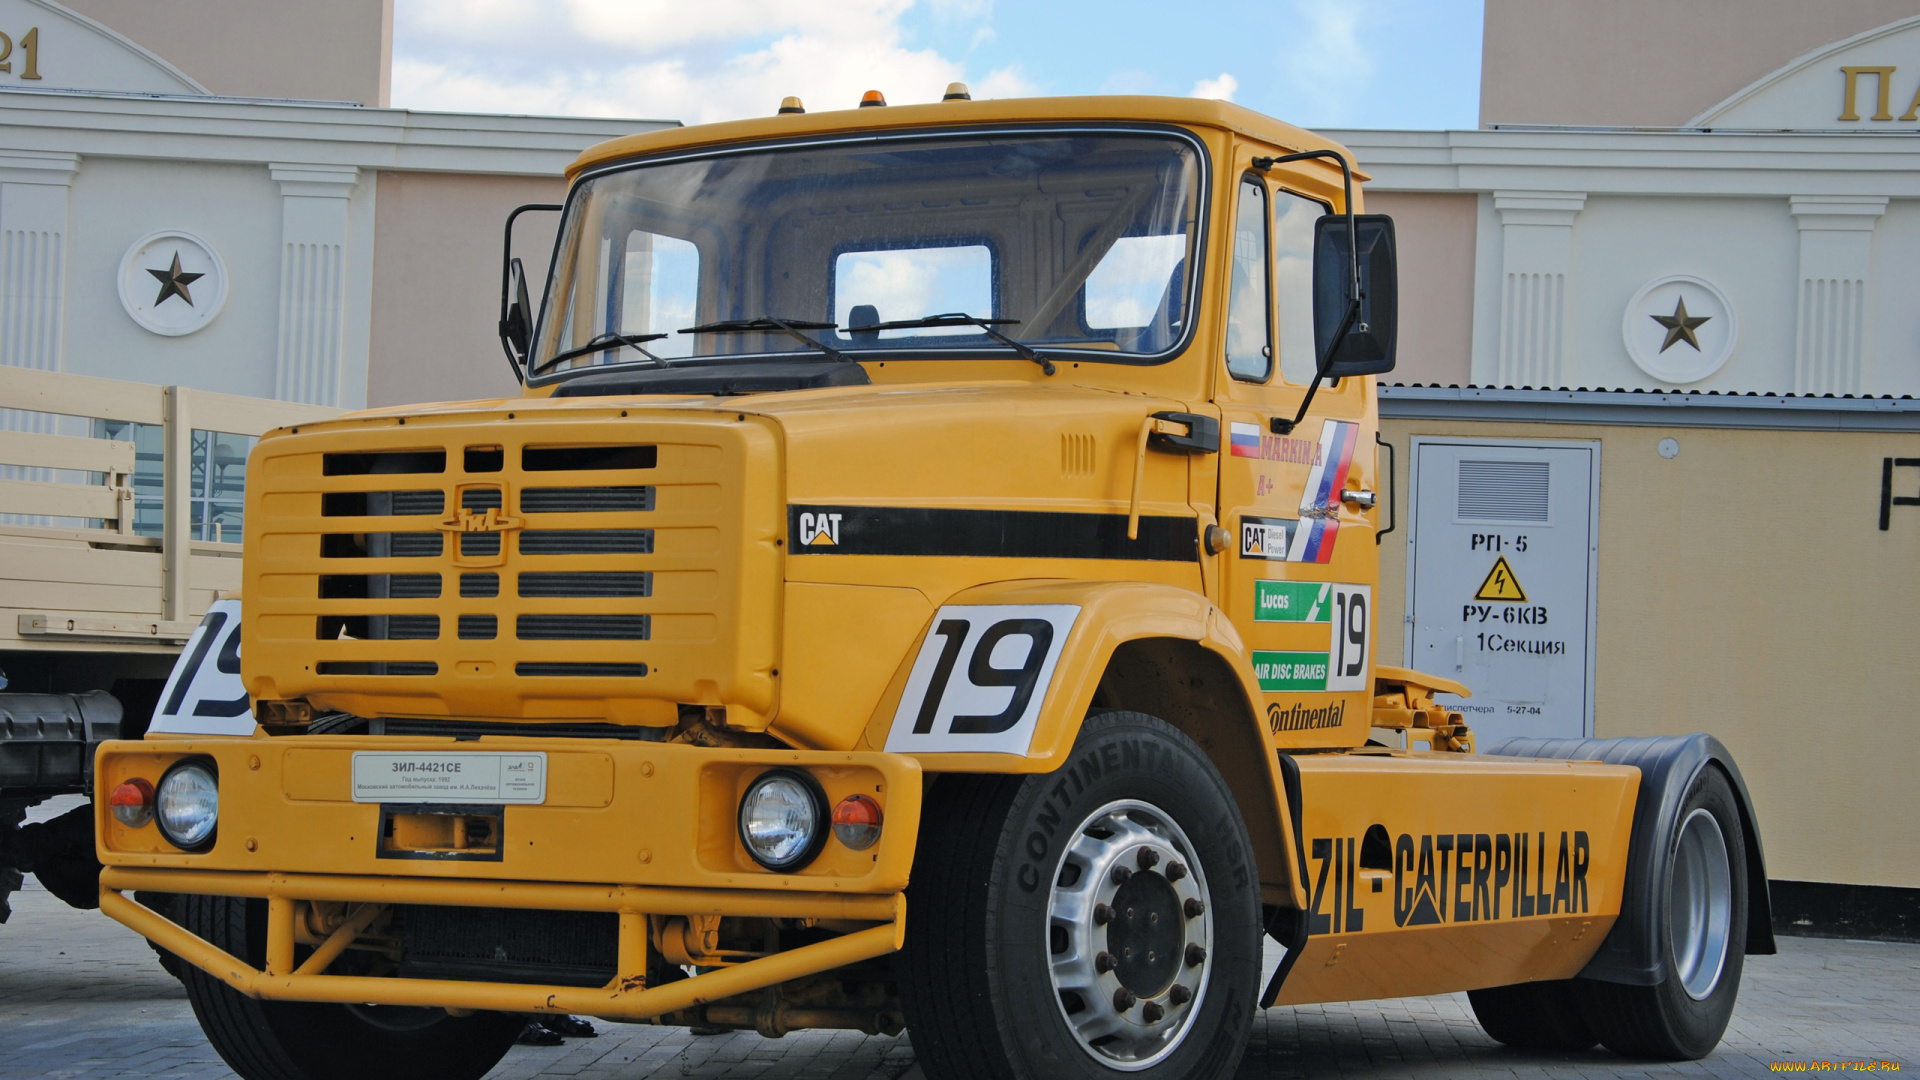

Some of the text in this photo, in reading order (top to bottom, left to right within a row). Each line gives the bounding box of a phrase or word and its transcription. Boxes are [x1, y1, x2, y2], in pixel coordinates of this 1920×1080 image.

[800, 512, 842, 545] CAT
[1267, 528, 1284, 541] Diesel
[1245, 527, 1265, 553] CAT
[1267, 543, 1285, 555] Power
[1260, 589, 1289, 609] Lucas
[1336, 592, 1366, 677] 19
[911, 618, 1054, 735] 19
[1255, 663, 1326, 681] AIR DISC BRAKES
[1507, 705, 1541, 715] 5-27-04
[392, 762, 461, 773] ЗИЛ-4421СЕ
[389, 783, 433, 791] автомобильный
